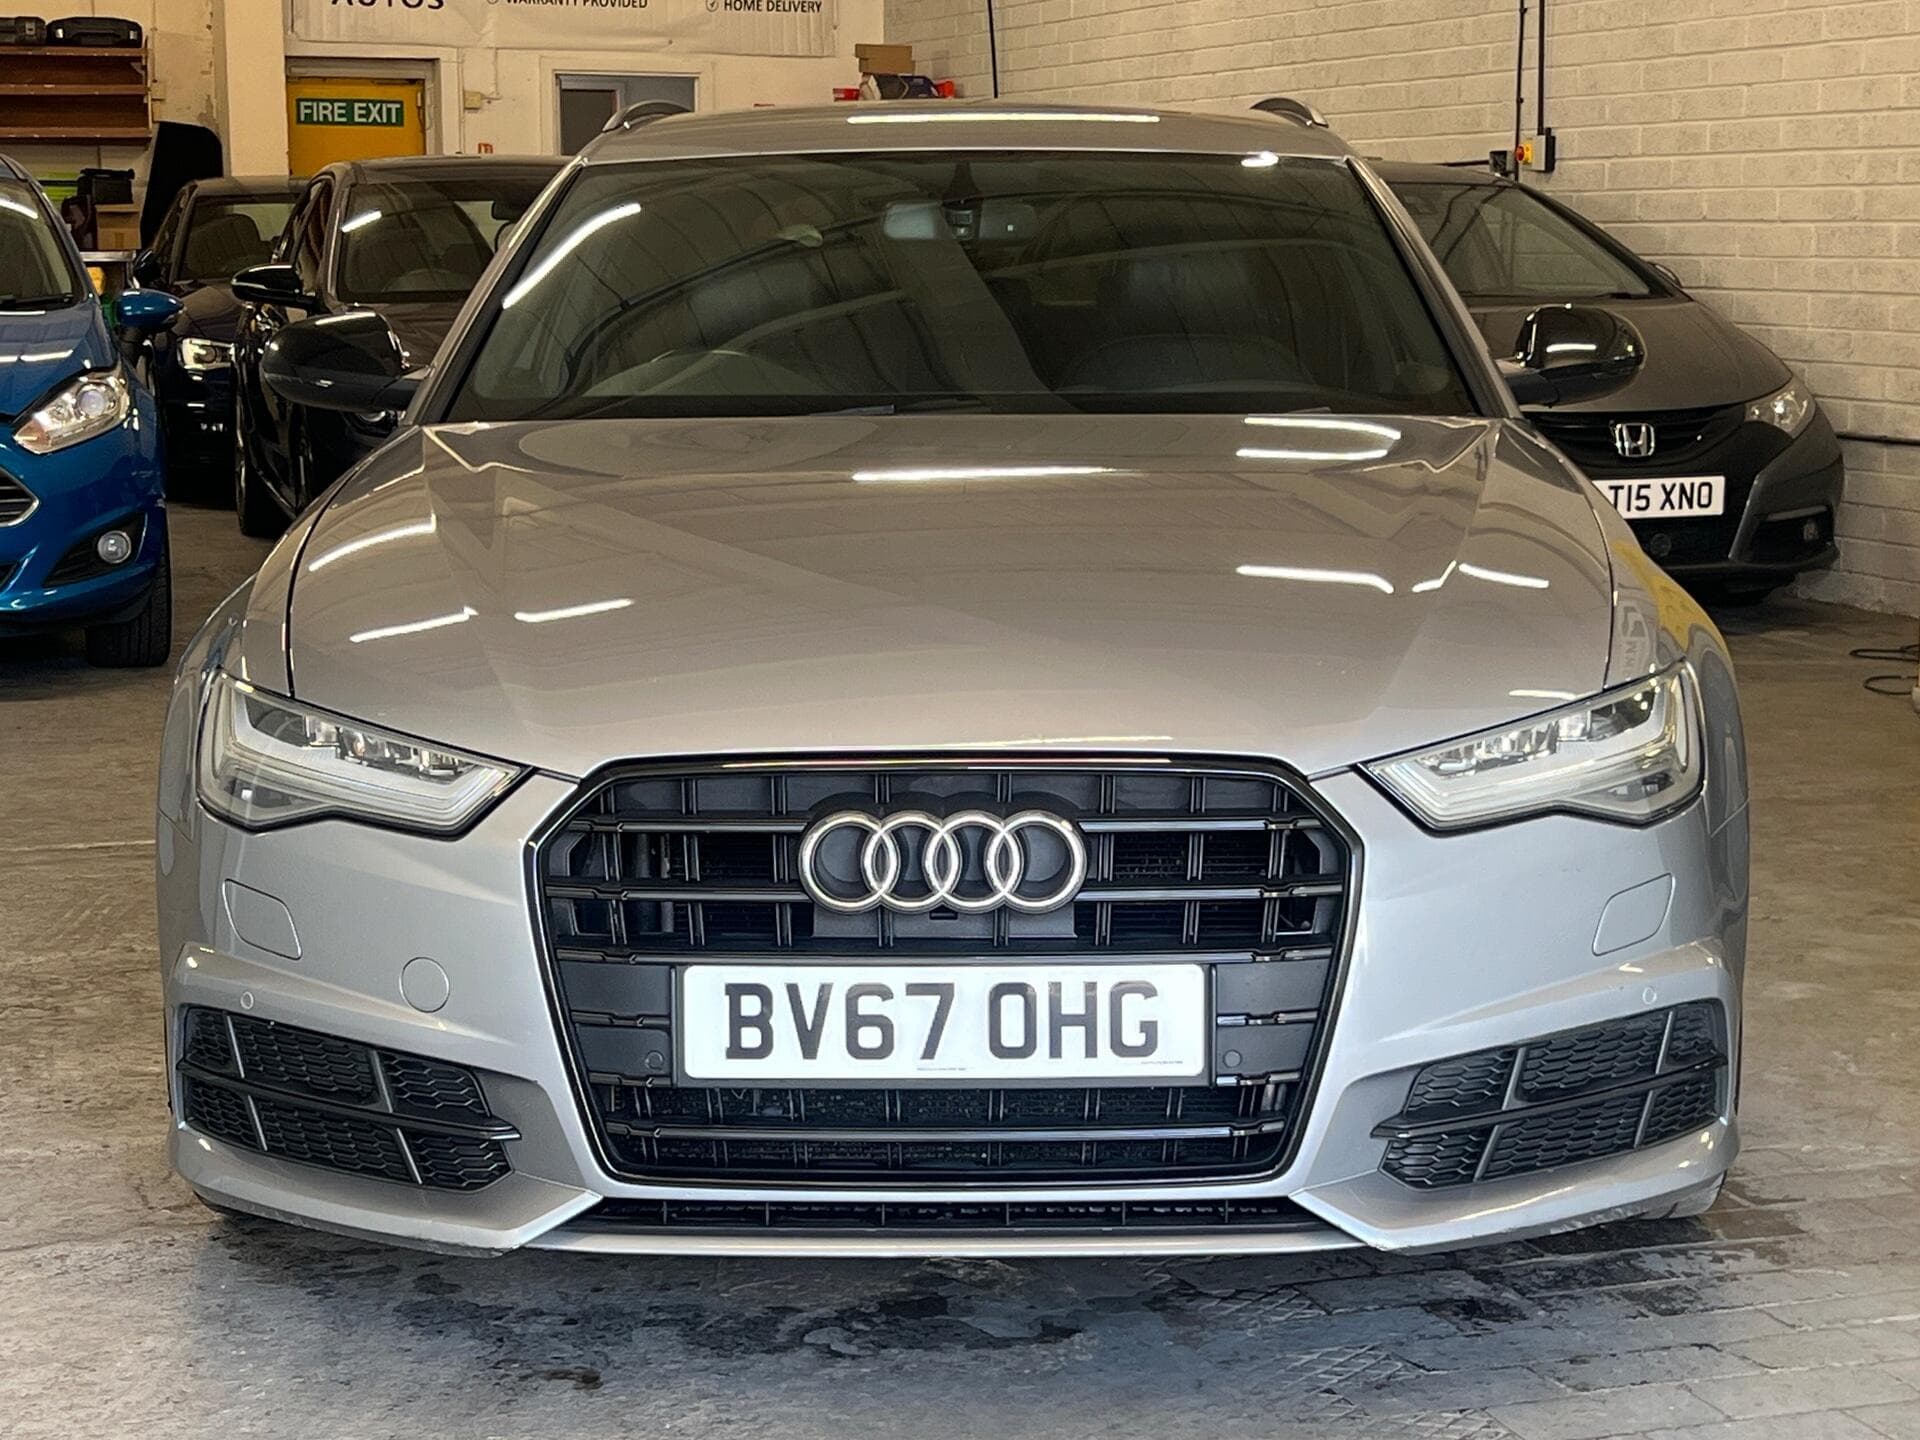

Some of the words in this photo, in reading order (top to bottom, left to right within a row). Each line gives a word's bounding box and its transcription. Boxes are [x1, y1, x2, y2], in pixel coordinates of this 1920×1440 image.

[724, 0, 762, 12] HOME
[766, 0, 822, 13] DELIVERY
[299, 101, 348, 122] FIRE
[353, 102, 401, 124] EXIT
[1659, 481, 1713, 511] XNO
[724, 981, 956, 1060] BV67
[987, 980, 1159, 1060] OHG
